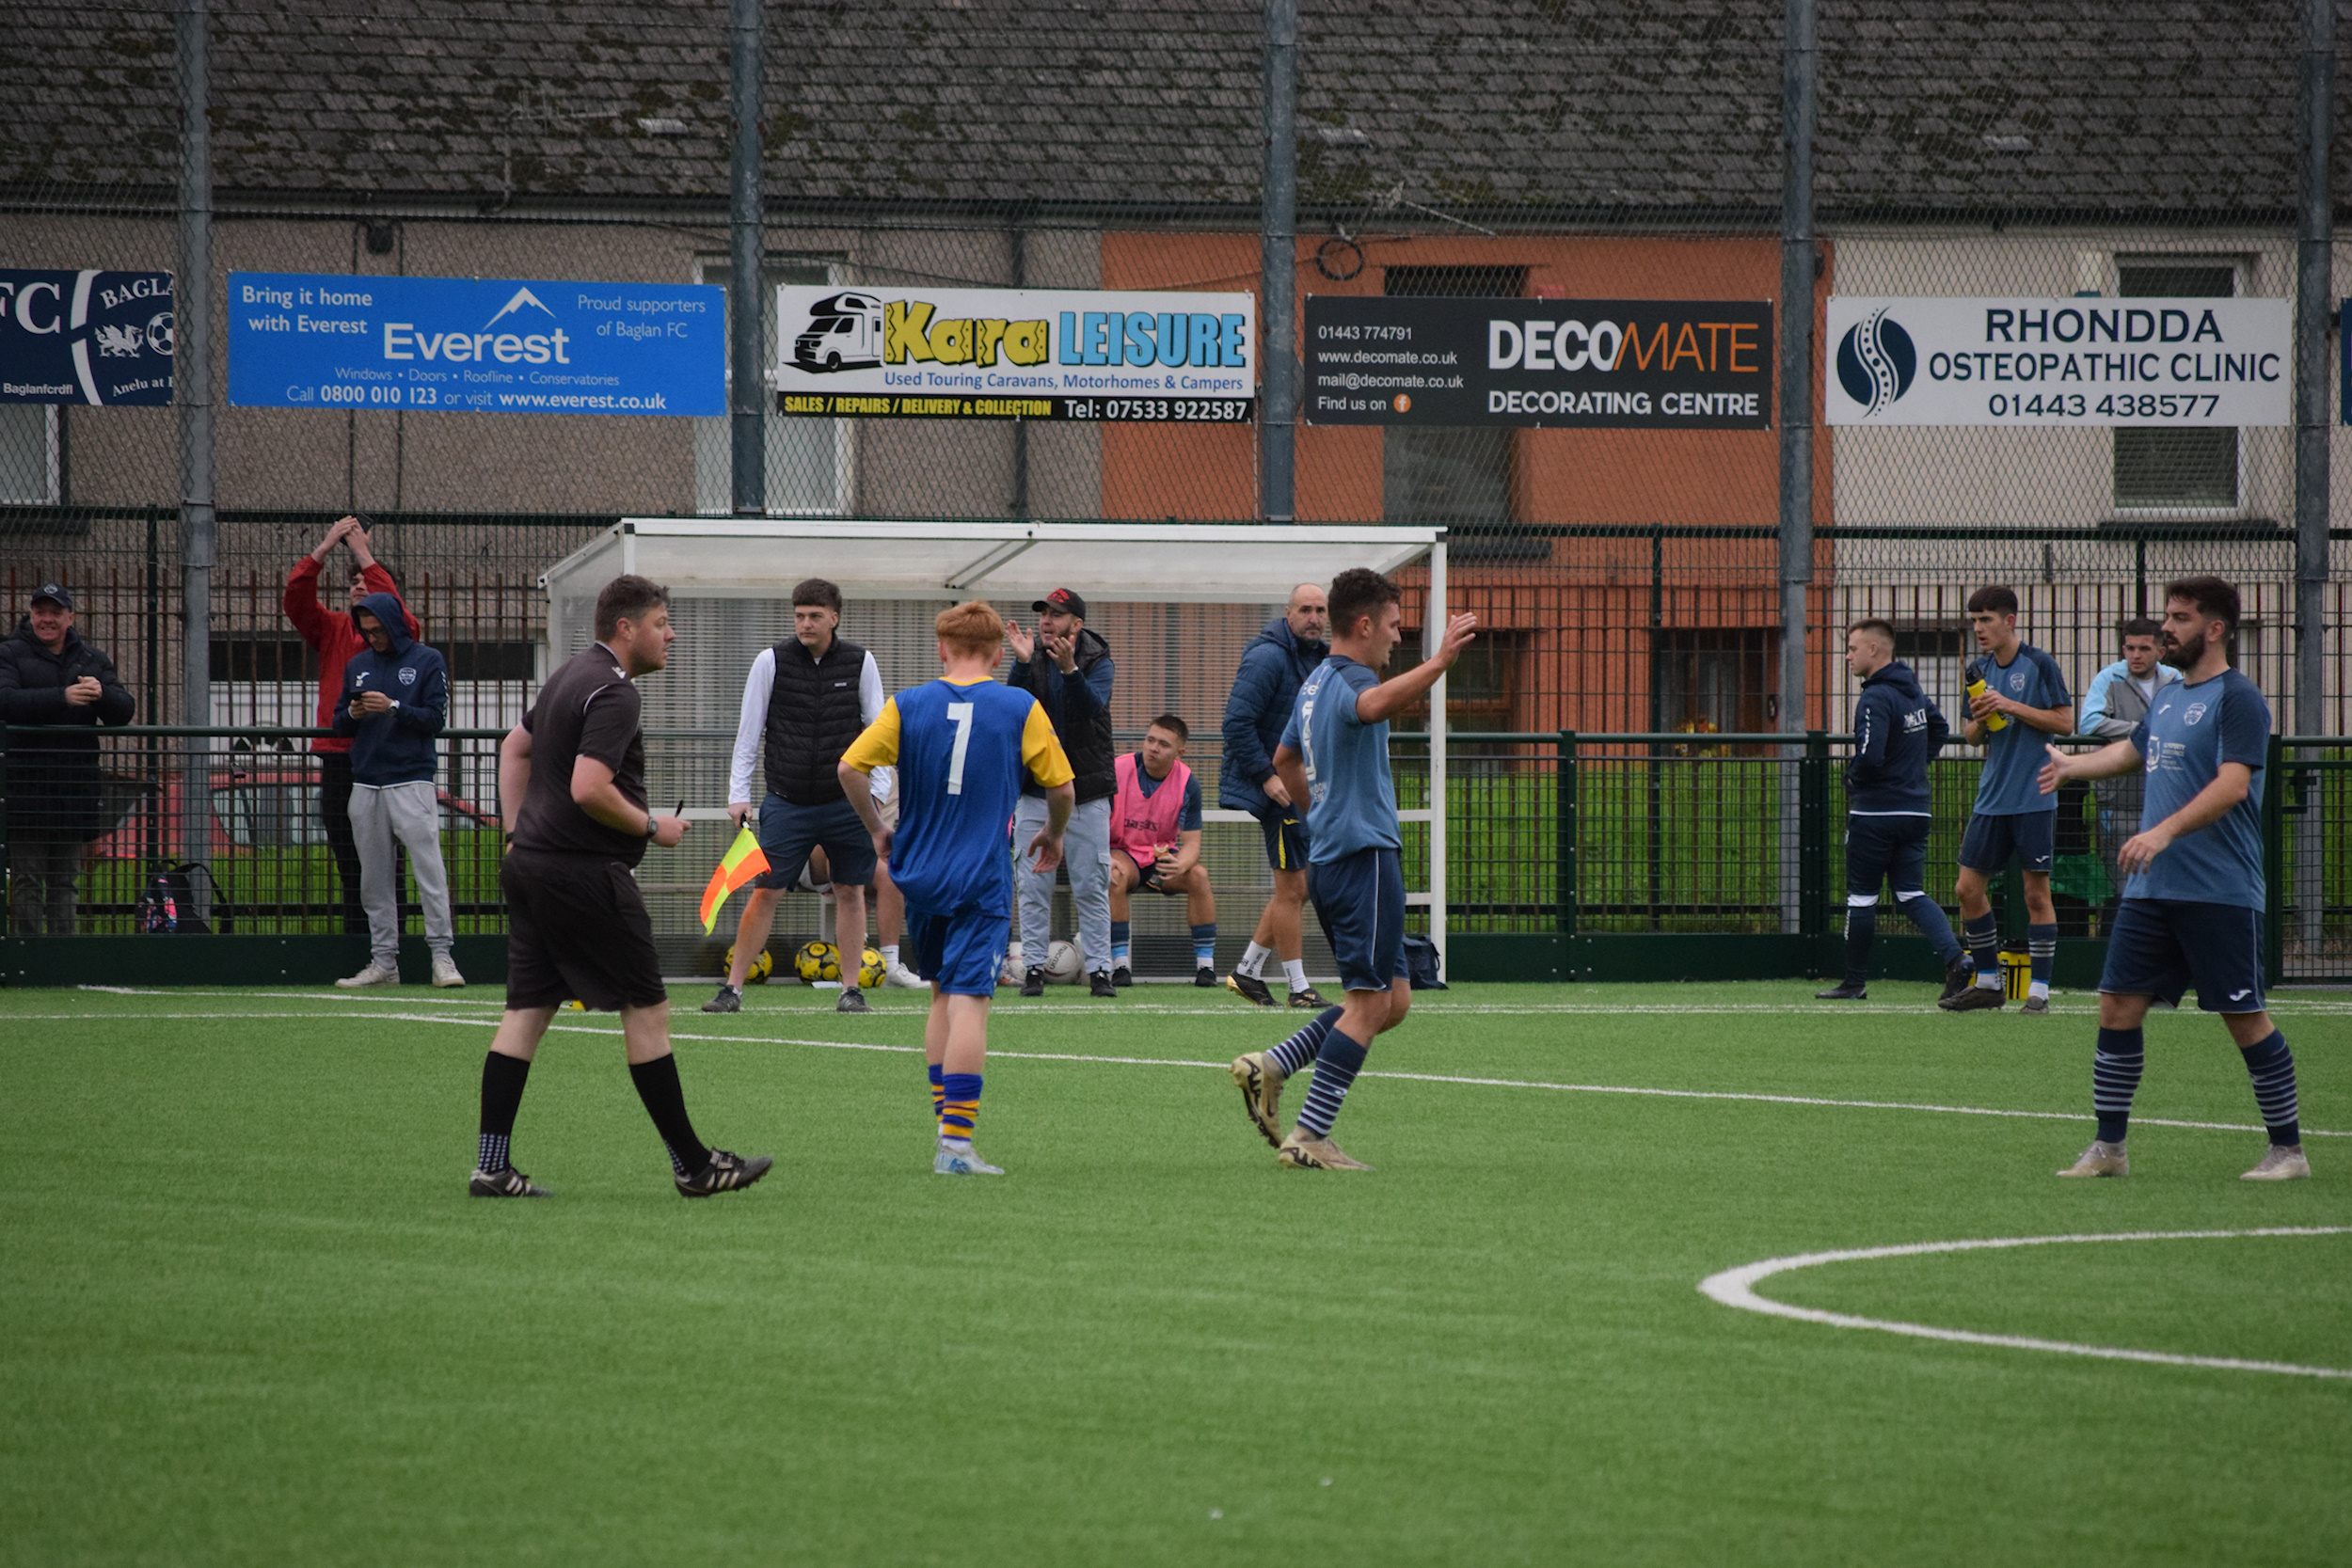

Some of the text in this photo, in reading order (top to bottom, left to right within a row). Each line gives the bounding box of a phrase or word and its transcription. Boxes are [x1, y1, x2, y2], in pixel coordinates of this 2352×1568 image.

[242, 286, 373, 309] Bring it home
[578, 295, 707, 316] Proud supporters
[248, 315, 368, 334] with Everest
[596, 321, 688, 341] of Baglan FC
[883, 299, 1247, 368] Kara LEISURE
[1318, 325, 1413, 341] 01443 774791
[1985, 308, 2224, 342] RHONDDA
[383, 323, 570, 364] Everest
[1488, 319, 1759, 372] DECOMATE
[1318, 349, 1458, 365] www.decomate.co.uk
[1929, 352, 2280, 383] OSTEOPATHIC CLINIC
[152, 377, 165, 388] at
[335, 367, 620, 386] Windows Doors Roofline Conservatories
[884, 372, 1243, 392] Used Touring Caravans, Motorhomes & Campers
[1318, 372, 1464, 389] mail@decomate.co.uk
[286, 386, 668, 409] Call 0800 010 123 or visit www.everest.co.uk
[784, 395, 825, 412] SALES
[835, 397, 891, 414] REPAIRS
[901, 398, 961, 415] DELIVERY
[962, 399, 973, 415] &
[976, 399, 1052, 416] COLLECTION
[1318, 396, 1346, 411] Find
[1350, 399, 1366, 411] us
[1369, 399, 1387, 411] on
[1488, 389, 1759, 416] DECORATING CENTRE
[1988, 393, 2220, 419] 01443 438577
[1065, 399, 1248, 420] Tel: 07533 922587
[1049, 944, 1069, 970] macron
